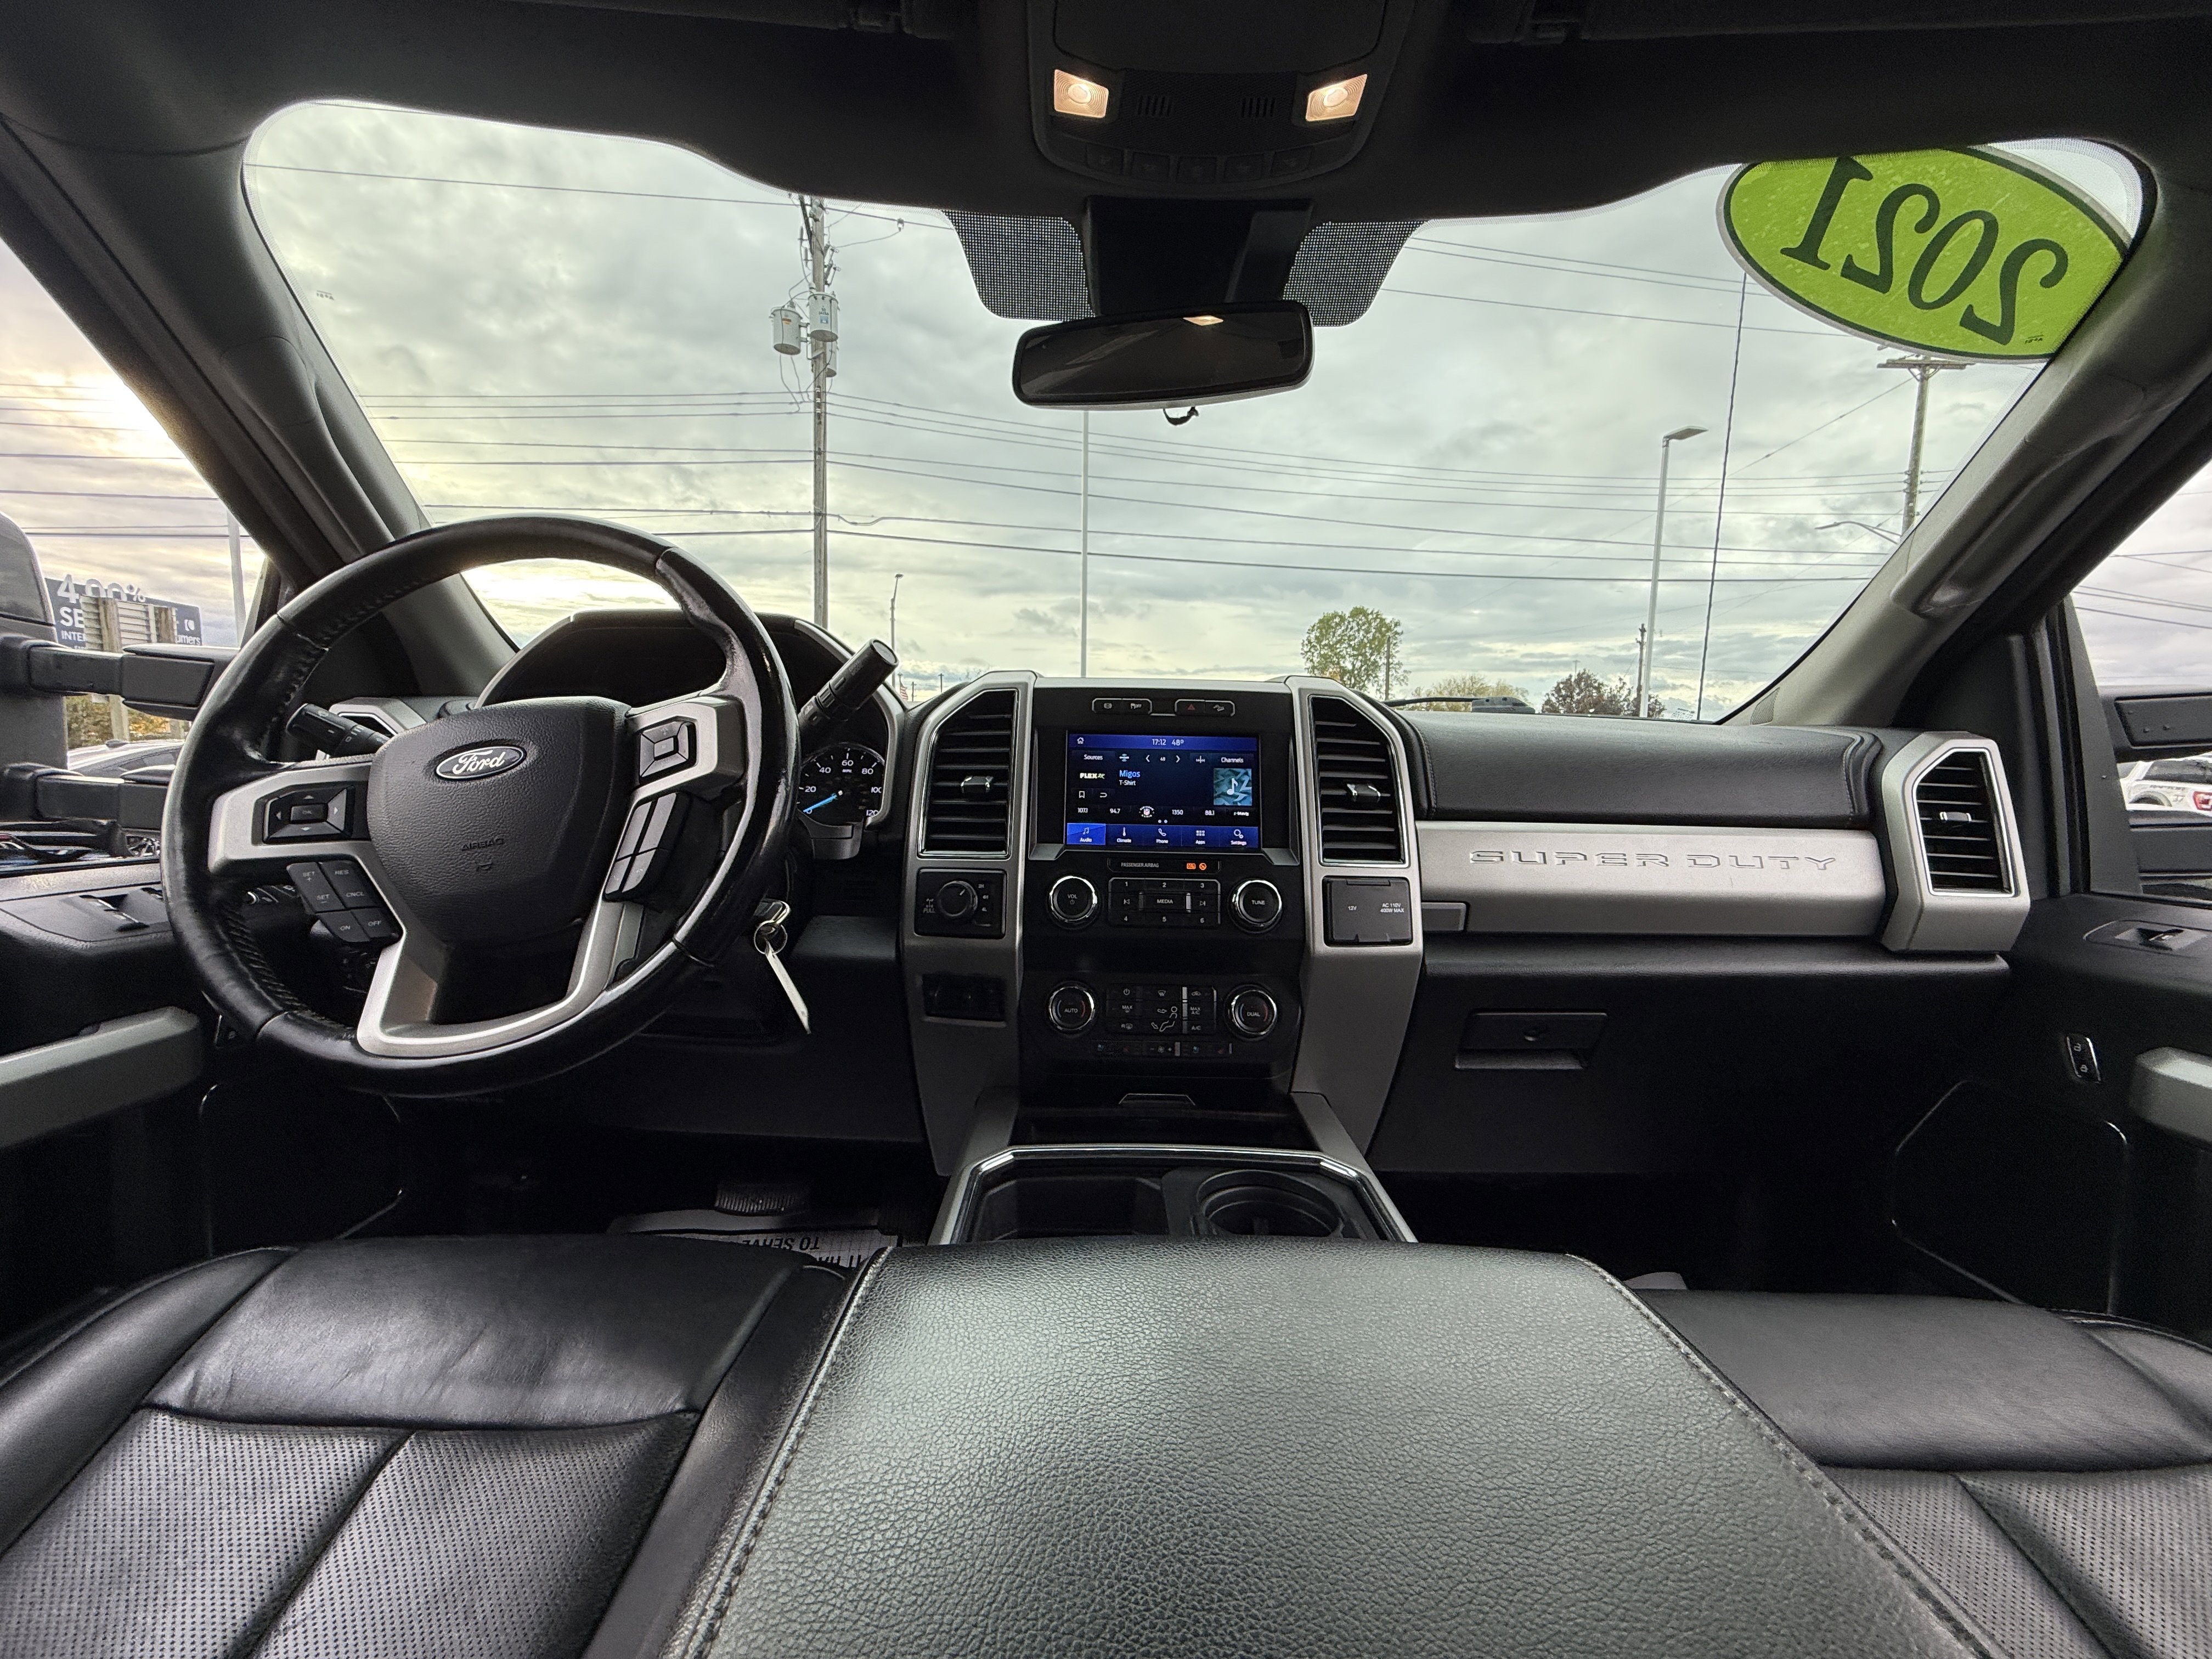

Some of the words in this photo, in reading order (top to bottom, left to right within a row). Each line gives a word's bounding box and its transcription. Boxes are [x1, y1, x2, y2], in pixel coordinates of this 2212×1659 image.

[452, 749, 506, 775] Ford
[1119, 770, 1141, 779] Migos
[1469, 850, 1669, 867] SUPER
[1686, 853, 1836, 871] DUTY
[799, 1236, 820, 1251] TO
